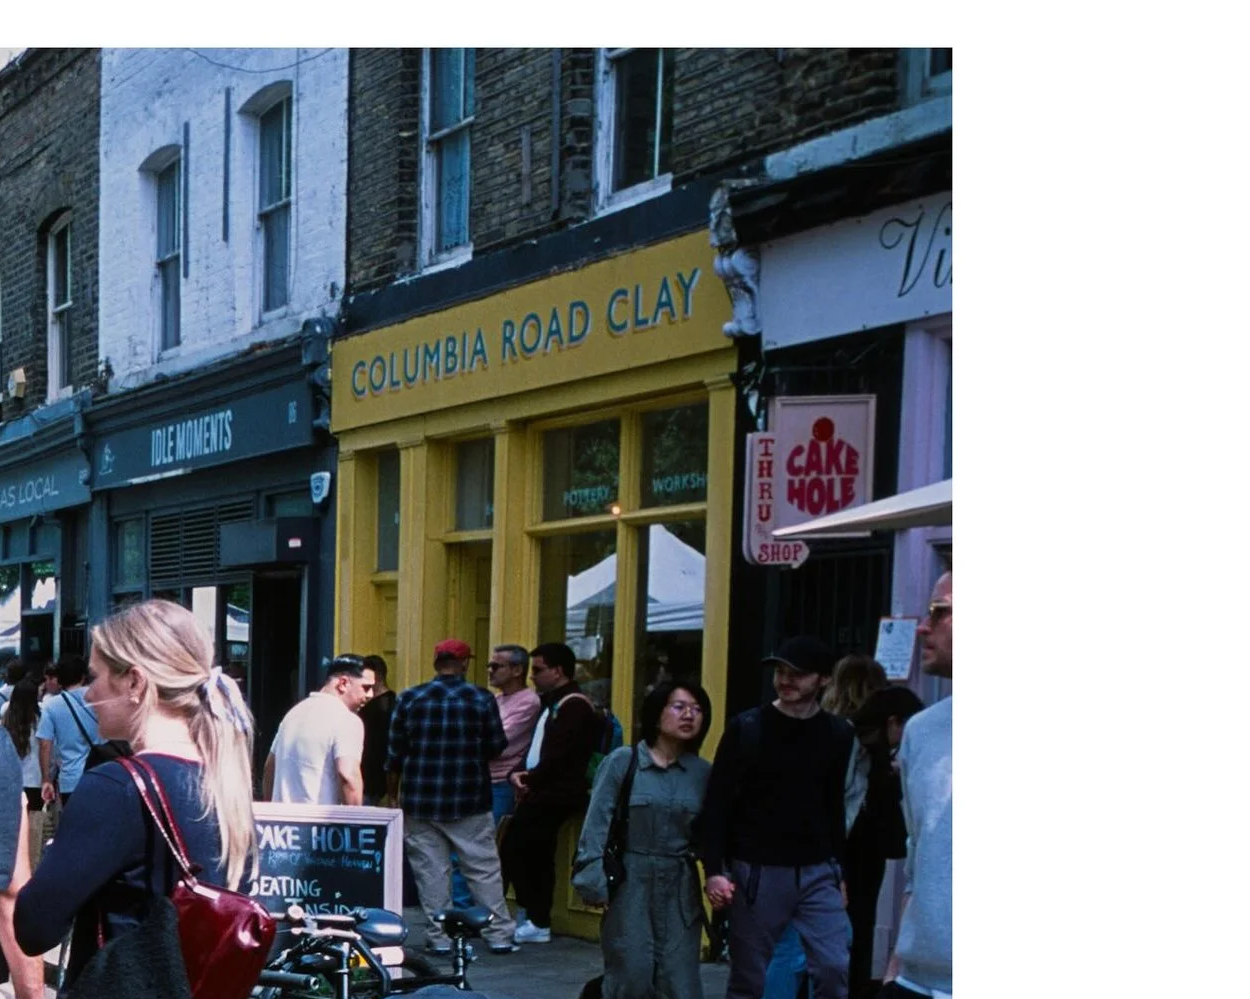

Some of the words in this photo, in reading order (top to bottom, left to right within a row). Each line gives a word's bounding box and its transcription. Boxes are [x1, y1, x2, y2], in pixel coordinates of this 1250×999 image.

[879, 201, 952, 298] Vi
[352, 327, 488, 398] COLUMBIA
[502, 300, 591, 362] ROAD
[606, 267, 702, 336] CLAY
[151, 424, 174, 466] IDLE
[175, 409, 233, 461] MOMENTS
[786, 438, 860, 477] CAKE
[19, 474, 60, 504] LOCAL
[653, 472, 708, 492] WORKSH
[758, 438, 775, 522] THRU
[787, 477, 856, 516] HOLE
[758, 543, 803, 563] SHOP
[311, 825, 377, 855] HOLE
